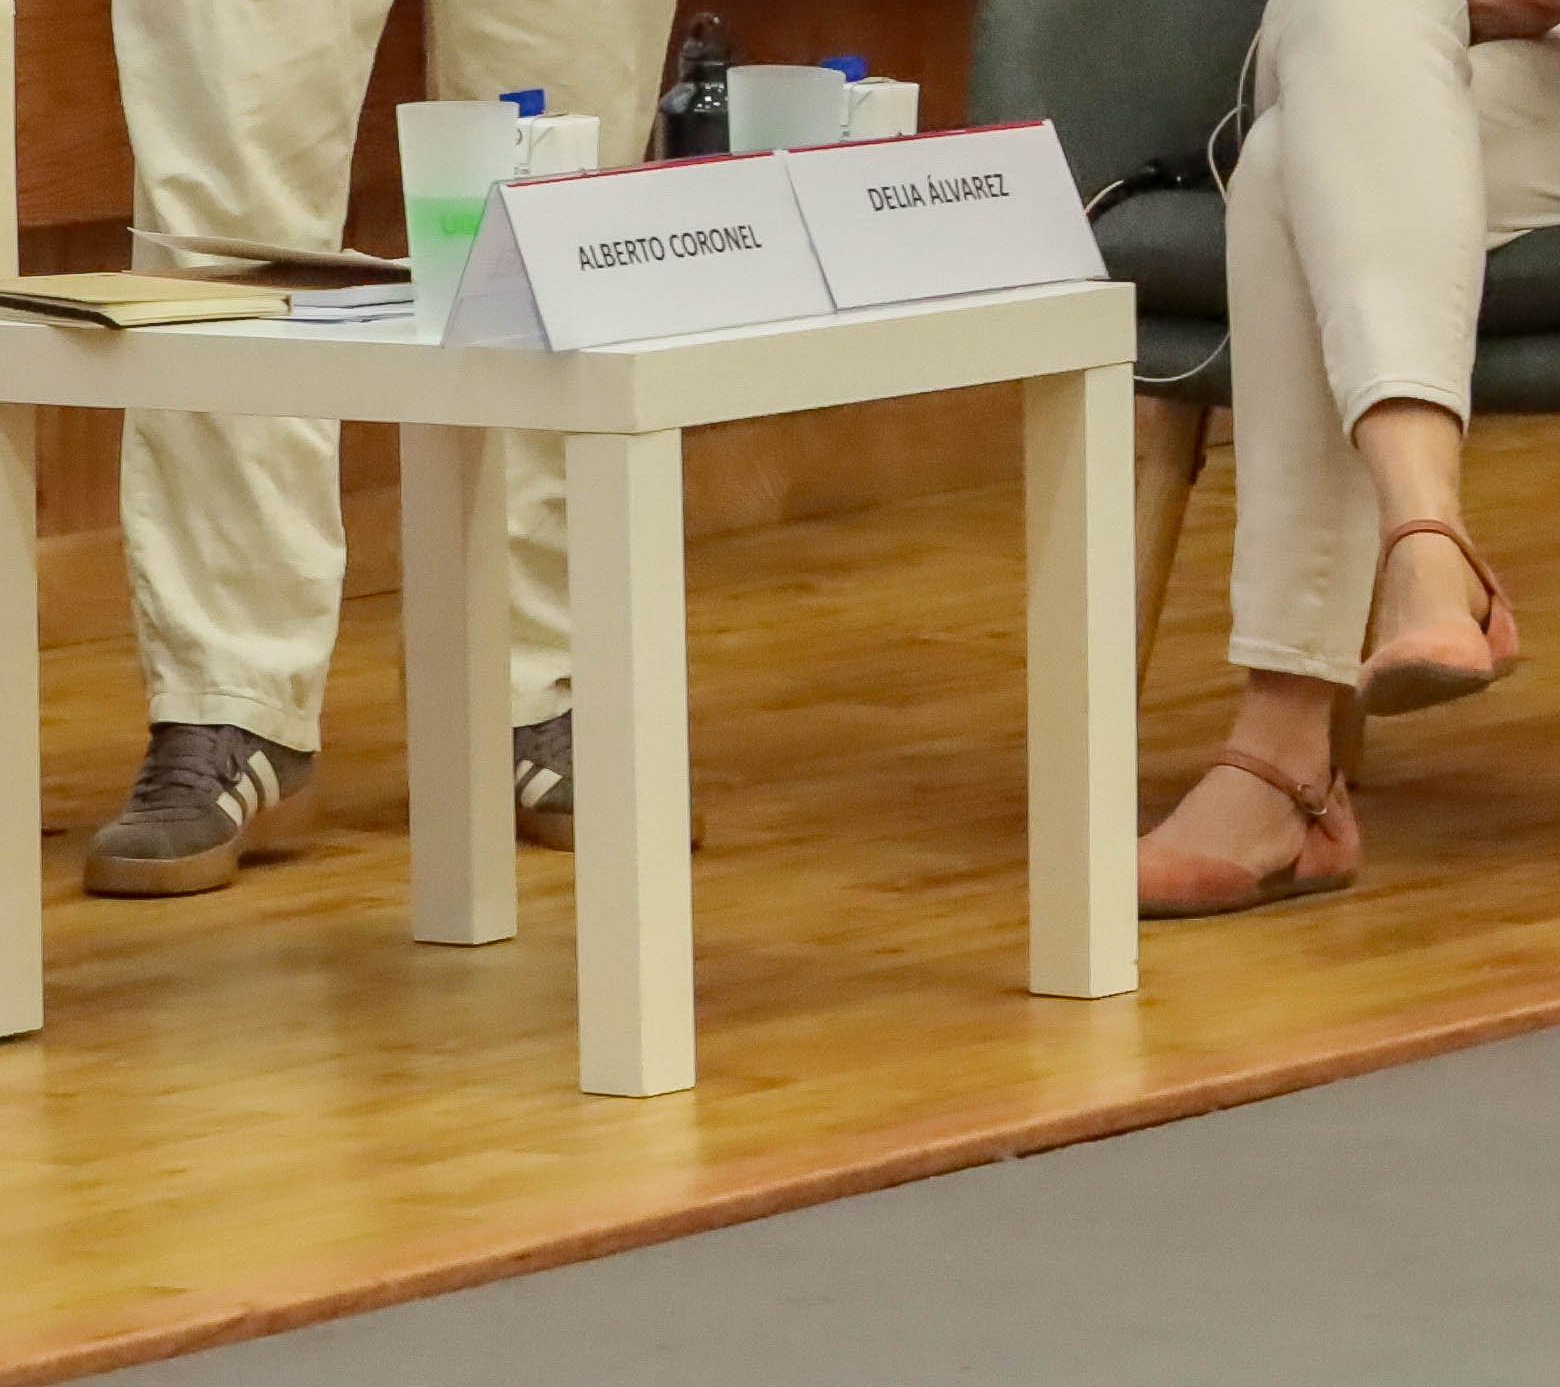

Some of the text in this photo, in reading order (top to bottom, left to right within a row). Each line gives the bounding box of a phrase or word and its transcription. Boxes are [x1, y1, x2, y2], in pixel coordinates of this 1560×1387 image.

[866, 172, 1010, 213] DELIA ÁLVAREZ
[577, 223, 763, 272] ALBERTO CORONEL
